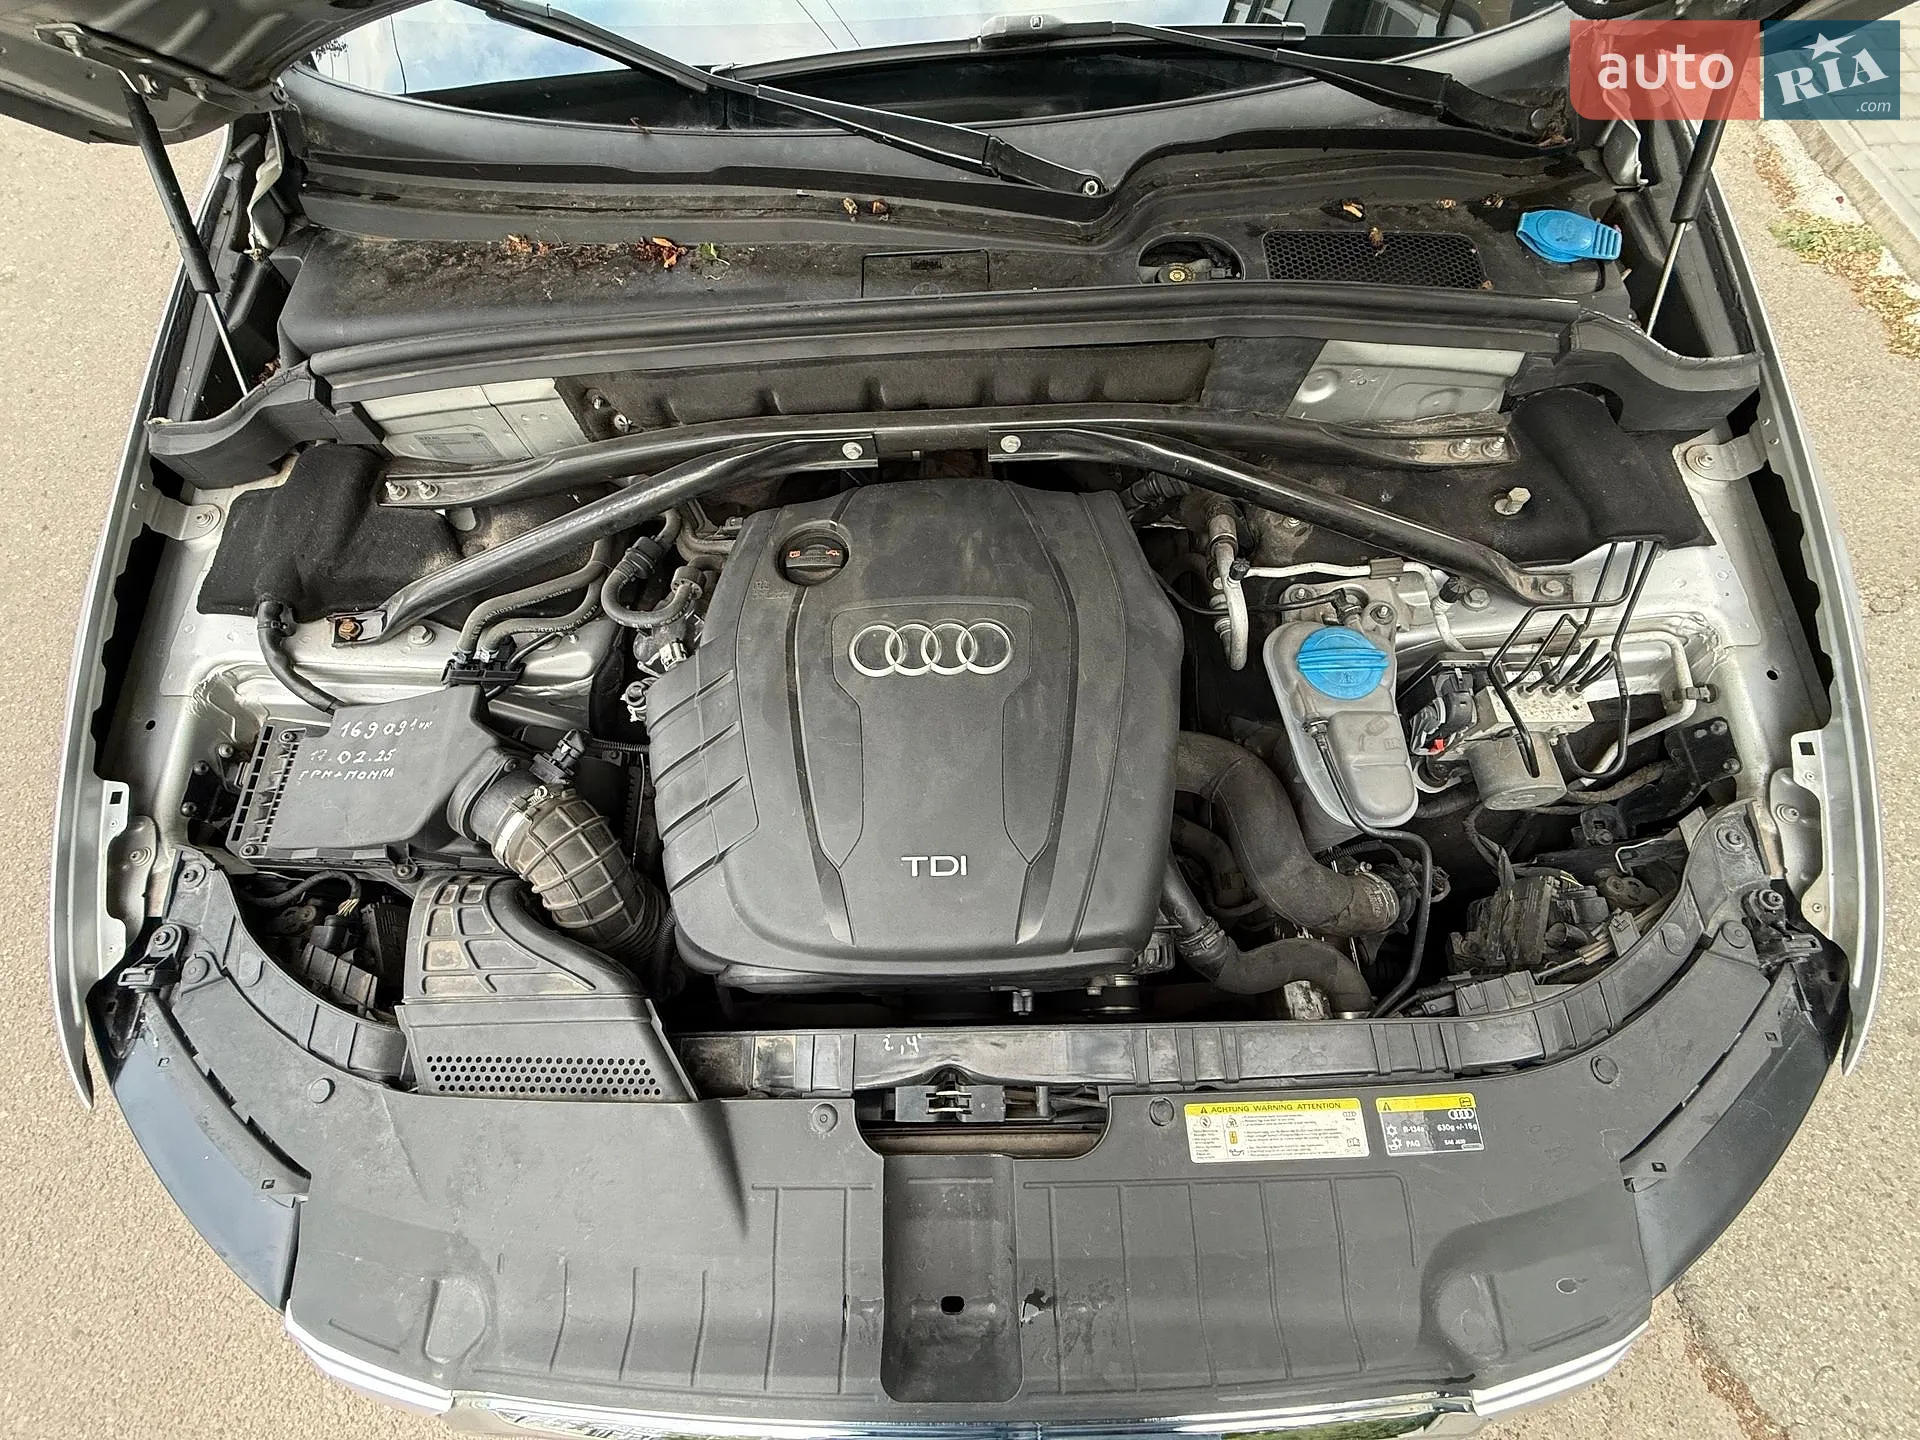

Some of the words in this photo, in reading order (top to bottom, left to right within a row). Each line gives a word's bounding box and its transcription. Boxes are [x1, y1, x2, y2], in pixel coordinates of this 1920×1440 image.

[900, 855, 968, 877] TDI
[1211, 1105, 1250, 1113] ACHTUNG
[1253, 1104, 1293, 1112] WARNING
[1297, 1102, 1341, 1110] ATTENTION
[1436, 1123, 1456, 1132] 630g
[1405, 1139, 1421, 1148] PAG
